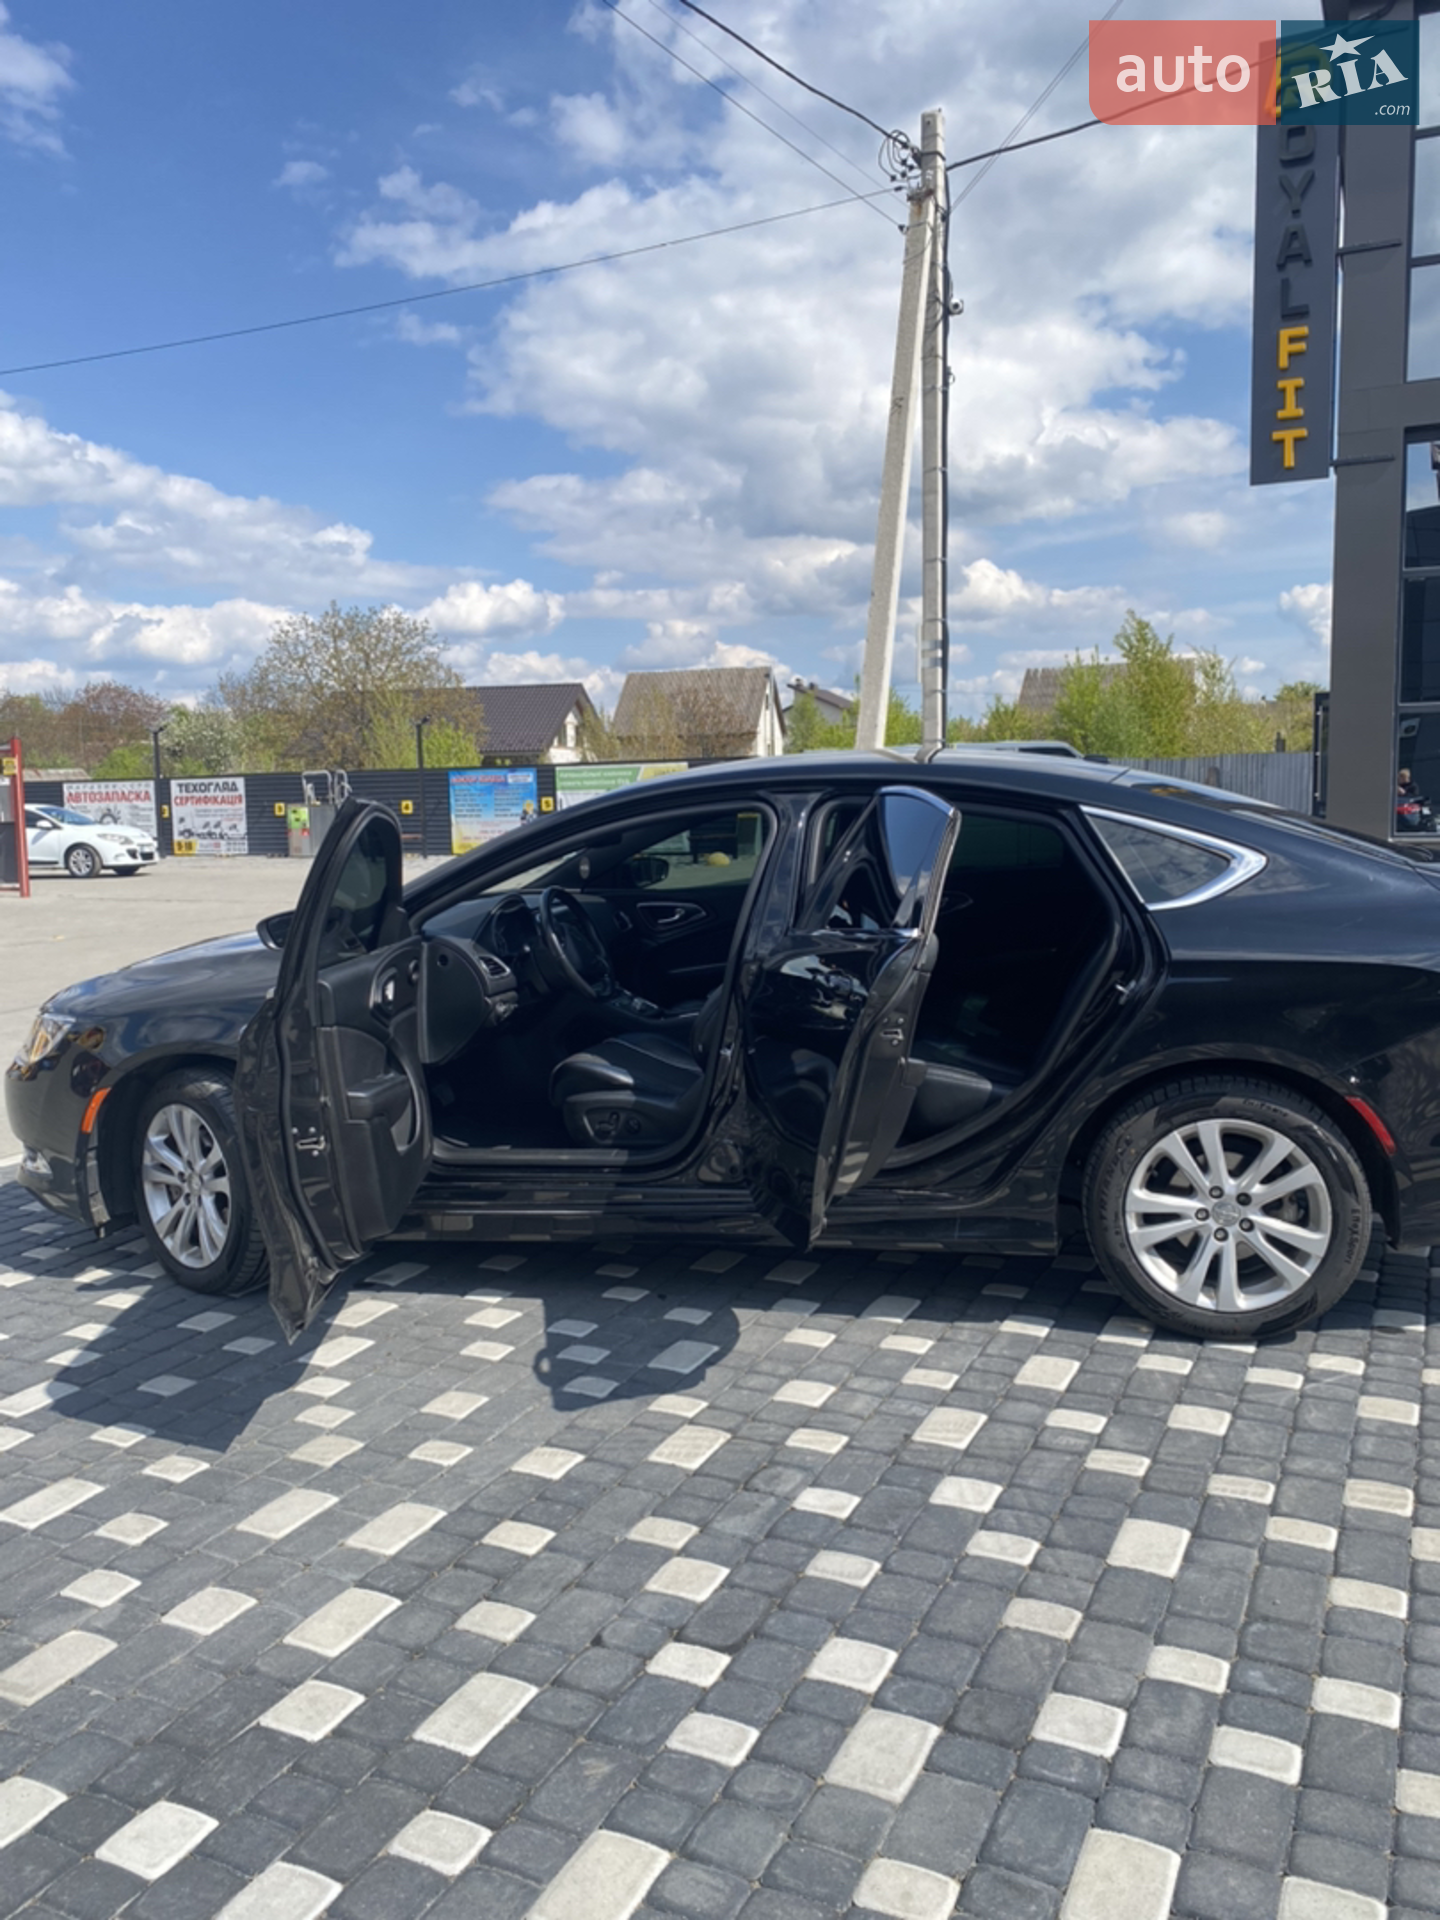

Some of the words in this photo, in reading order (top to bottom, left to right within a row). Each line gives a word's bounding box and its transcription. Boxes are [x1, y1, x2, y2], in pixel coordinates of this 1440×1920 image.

[177, 782, 239, 793] ТЕХОГЛЯД
[66, 790, 151, 804] АВТОЗАПАСКА
[174, 795, 242, 806] СЕРТИФІКАЦІЯ
